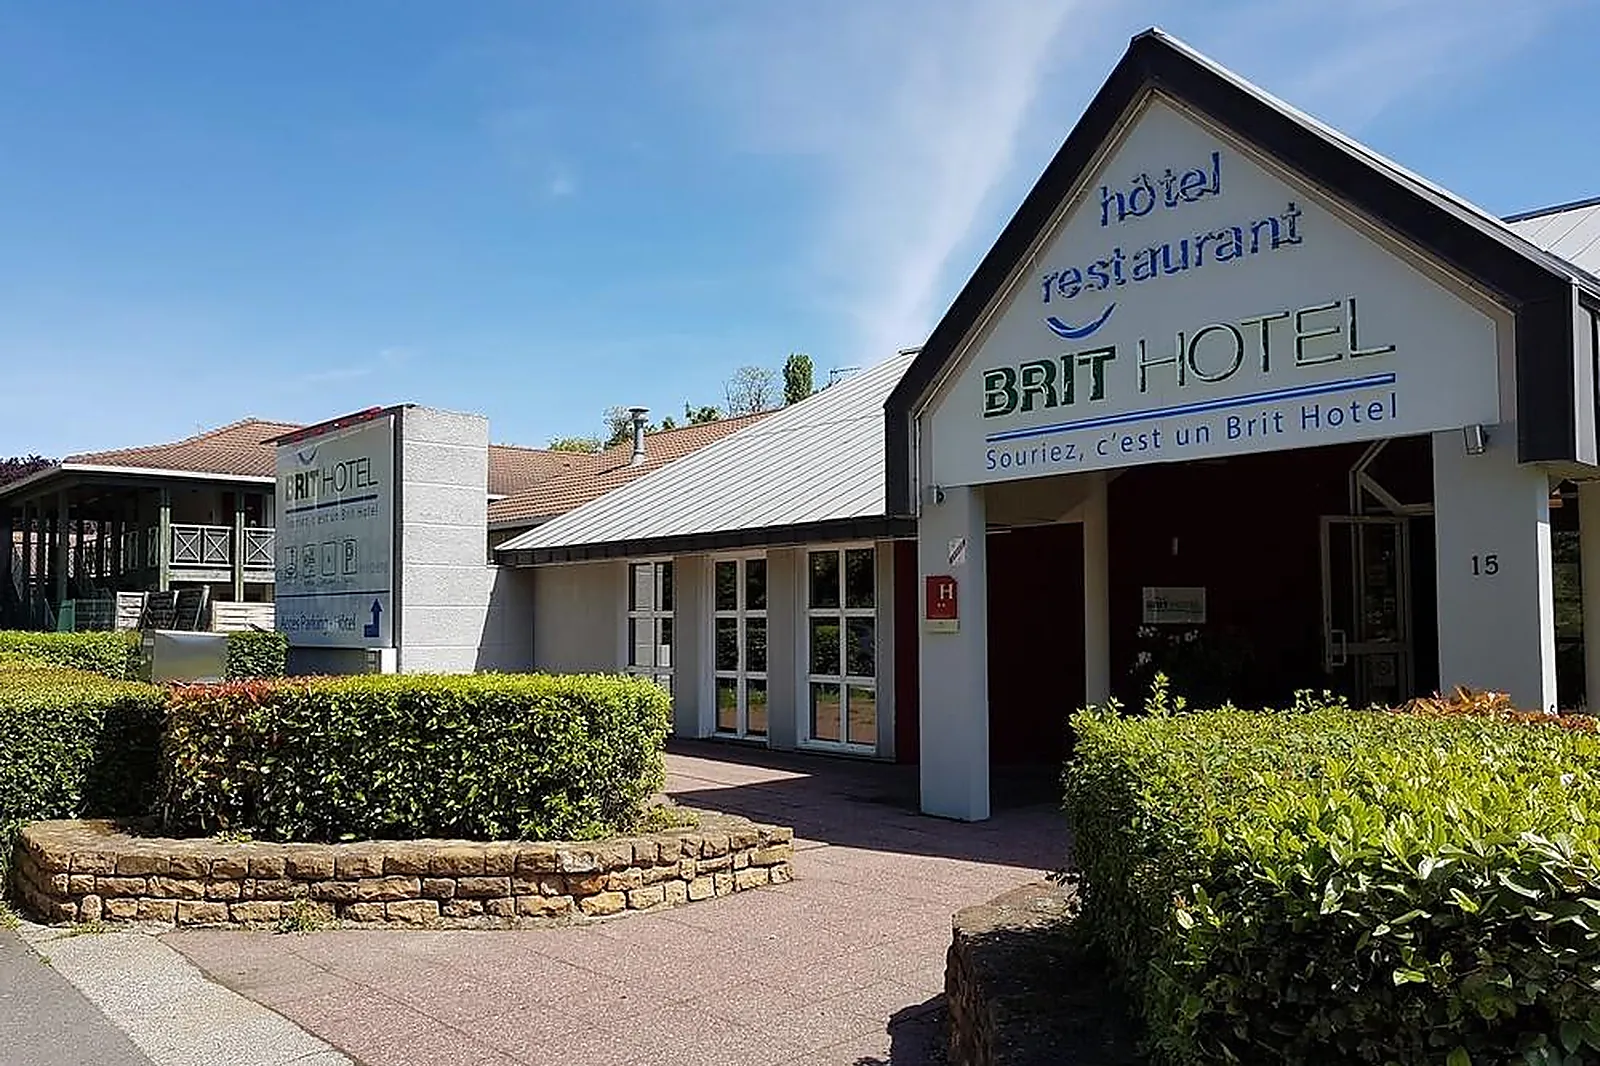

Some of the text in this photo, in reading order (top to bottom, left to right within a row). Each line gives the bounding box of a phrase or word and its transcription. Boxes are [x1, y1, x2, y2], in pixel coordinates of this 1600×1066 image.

[1042, 202, 1304, 304] restaurant
[982, 297, 1397, 419] BRIT HOTEL
[986, 392, 1397, 471] Souriez, c'est un Brit Hotel
[285, 457, 378, 501] BRIT HOTEL
[940, 583, 953, 600] H
[1471, 555, 1499, 575] 15
